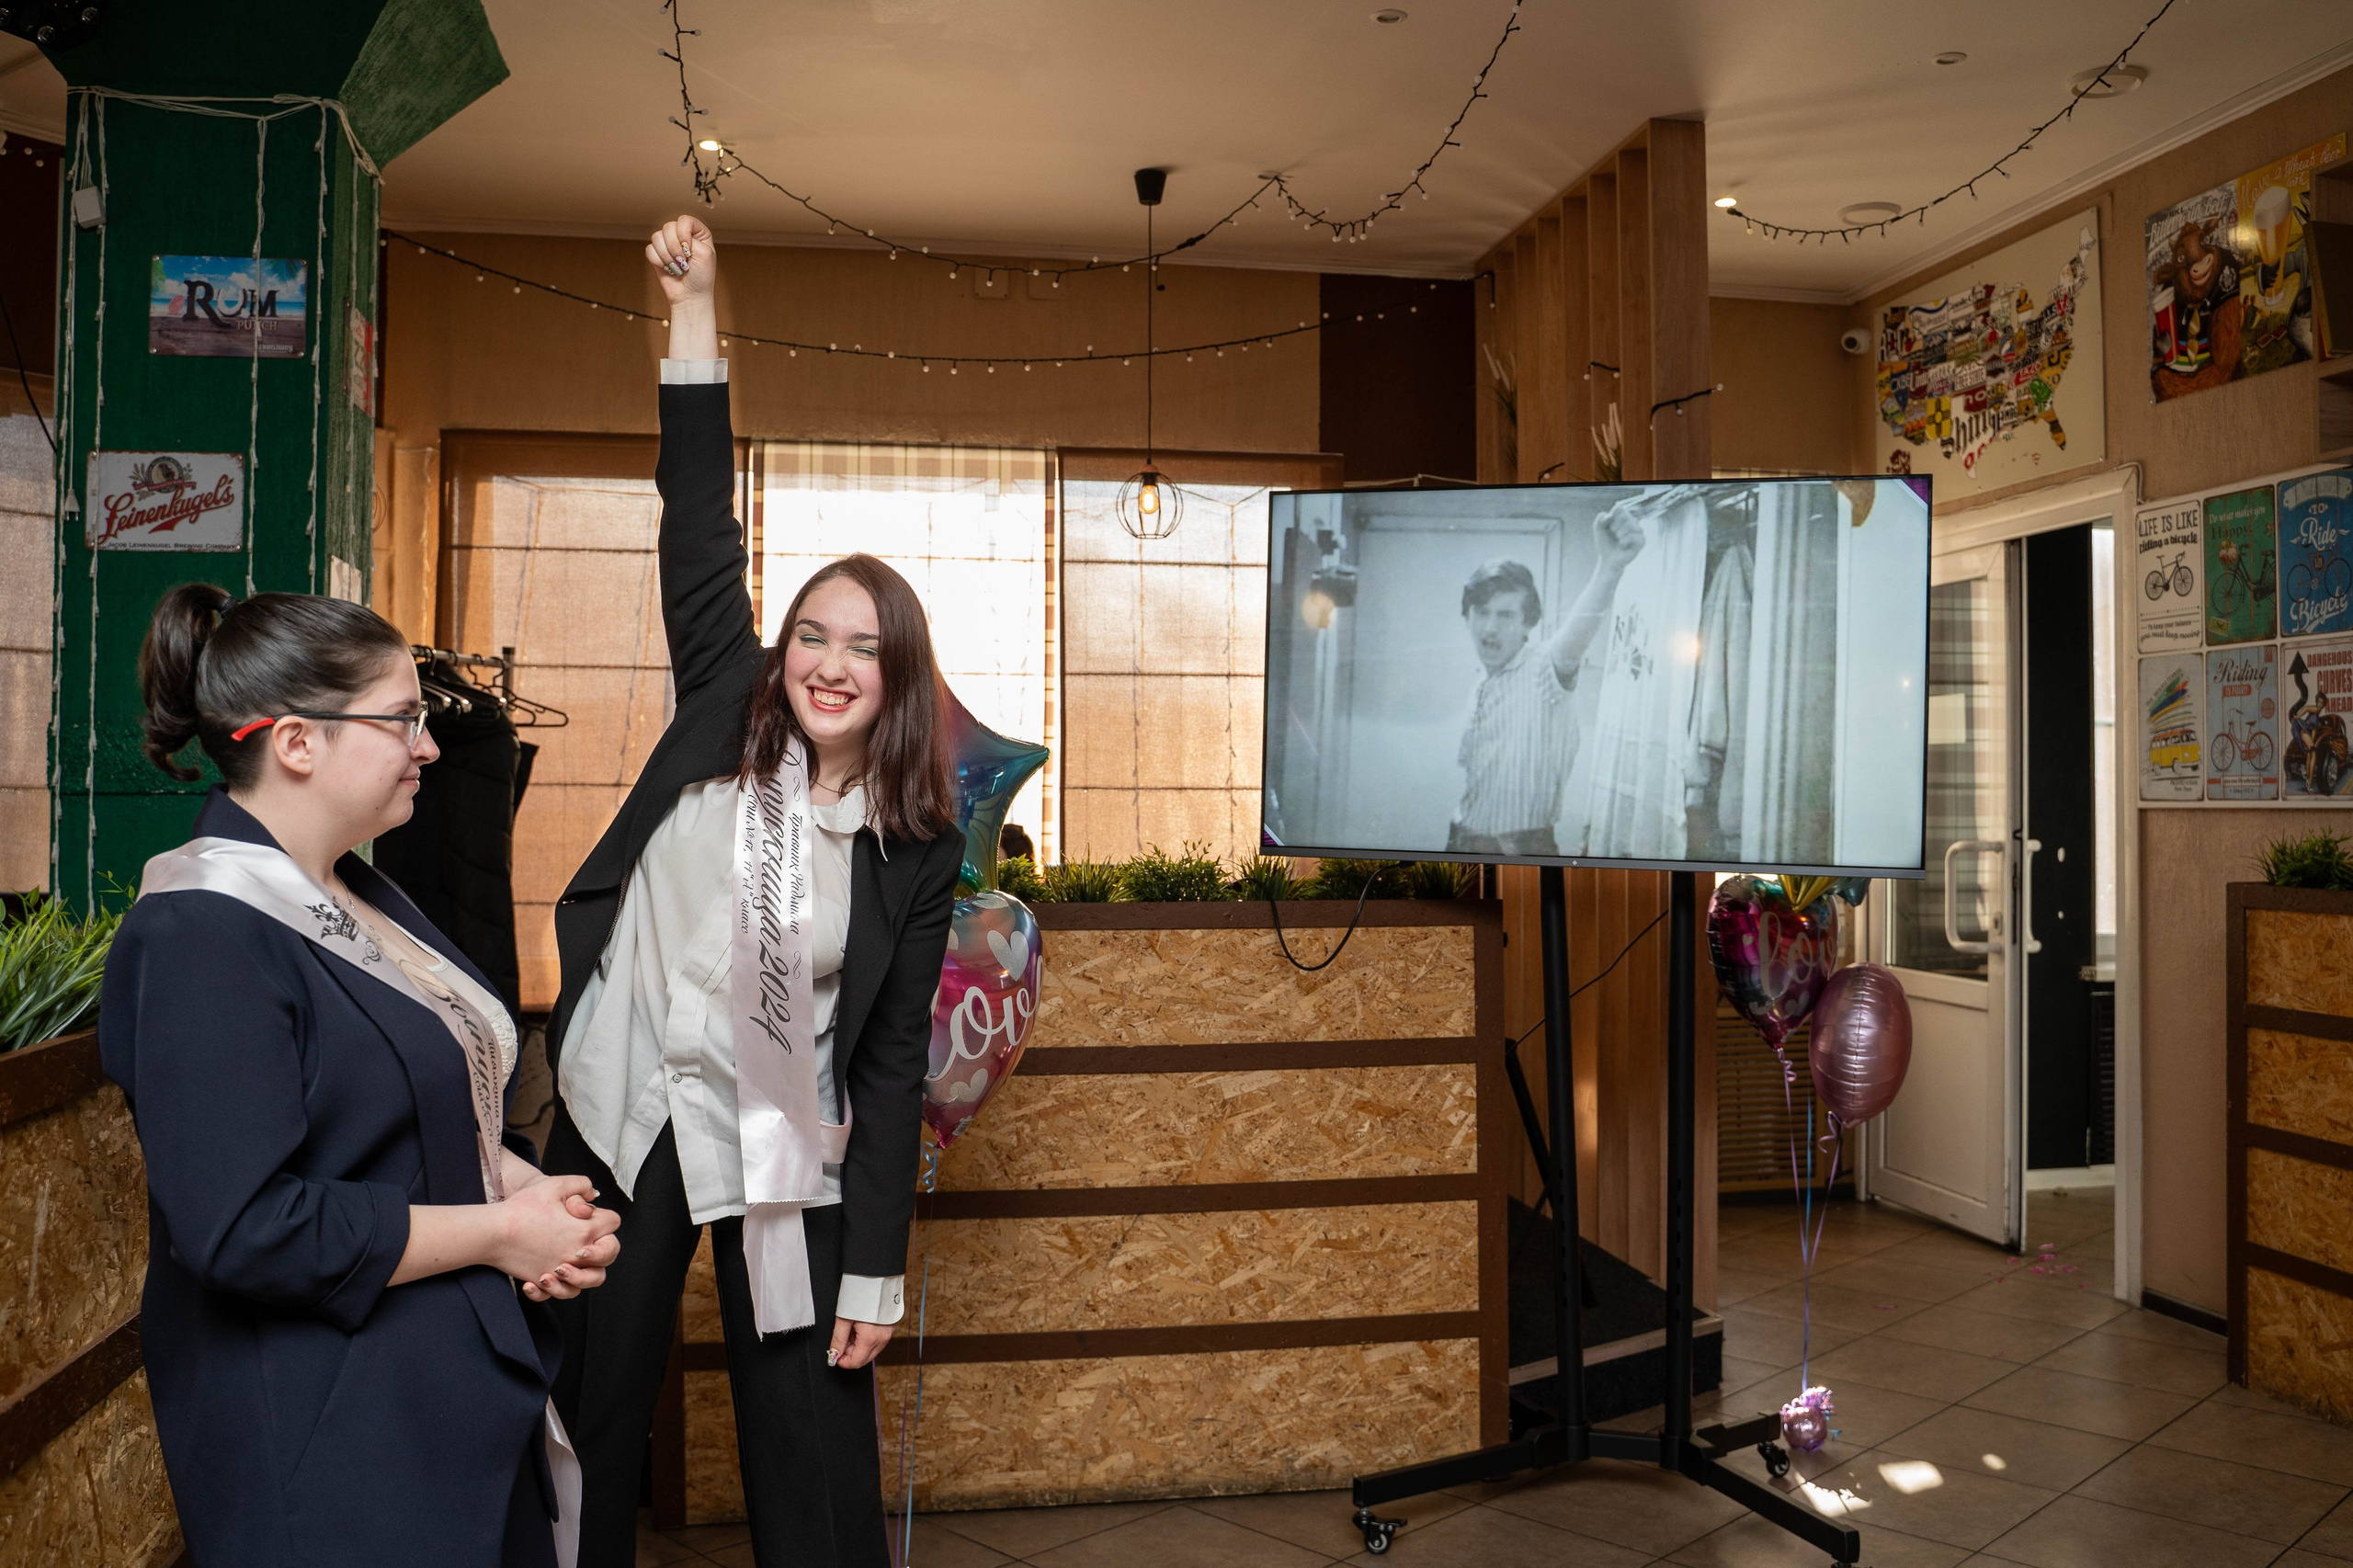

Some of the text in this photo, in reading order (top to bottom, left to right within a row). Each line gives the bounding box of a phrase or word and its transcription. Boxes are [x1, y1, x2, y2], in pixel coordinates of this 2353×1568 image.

[2273, 166, 2282, 180] a
[183, 279, 279, 328] RUM
[97, 474, 234, 544] Leinenkugel's
[2209, 505, 2266, 524] Do what makes you
[2311, 503, 2325, 514] TO
[2139, 509, 2198, 537] LIFE IS LIKE
[2300, 517, 2337, 550] Ride
[2139, 538, 2163, 553] riding
[2170, 531, 2198, 545] bicycle
[2290, 585, 2348, 633] Bicycle
[2213, 656, 2268, 689] Riding
[2306, 651, 2352, 667] DANGEROUS
[2316, 668, 2352, 694] CURVES
[2325, 696, 2352, 713] AHEAD
[746, 794, 758, 821] СОШ
[789, 812, 802, 869] Правник
[740, 898, 750, 934] класс
[749, 939, 792, 1055] 2024
